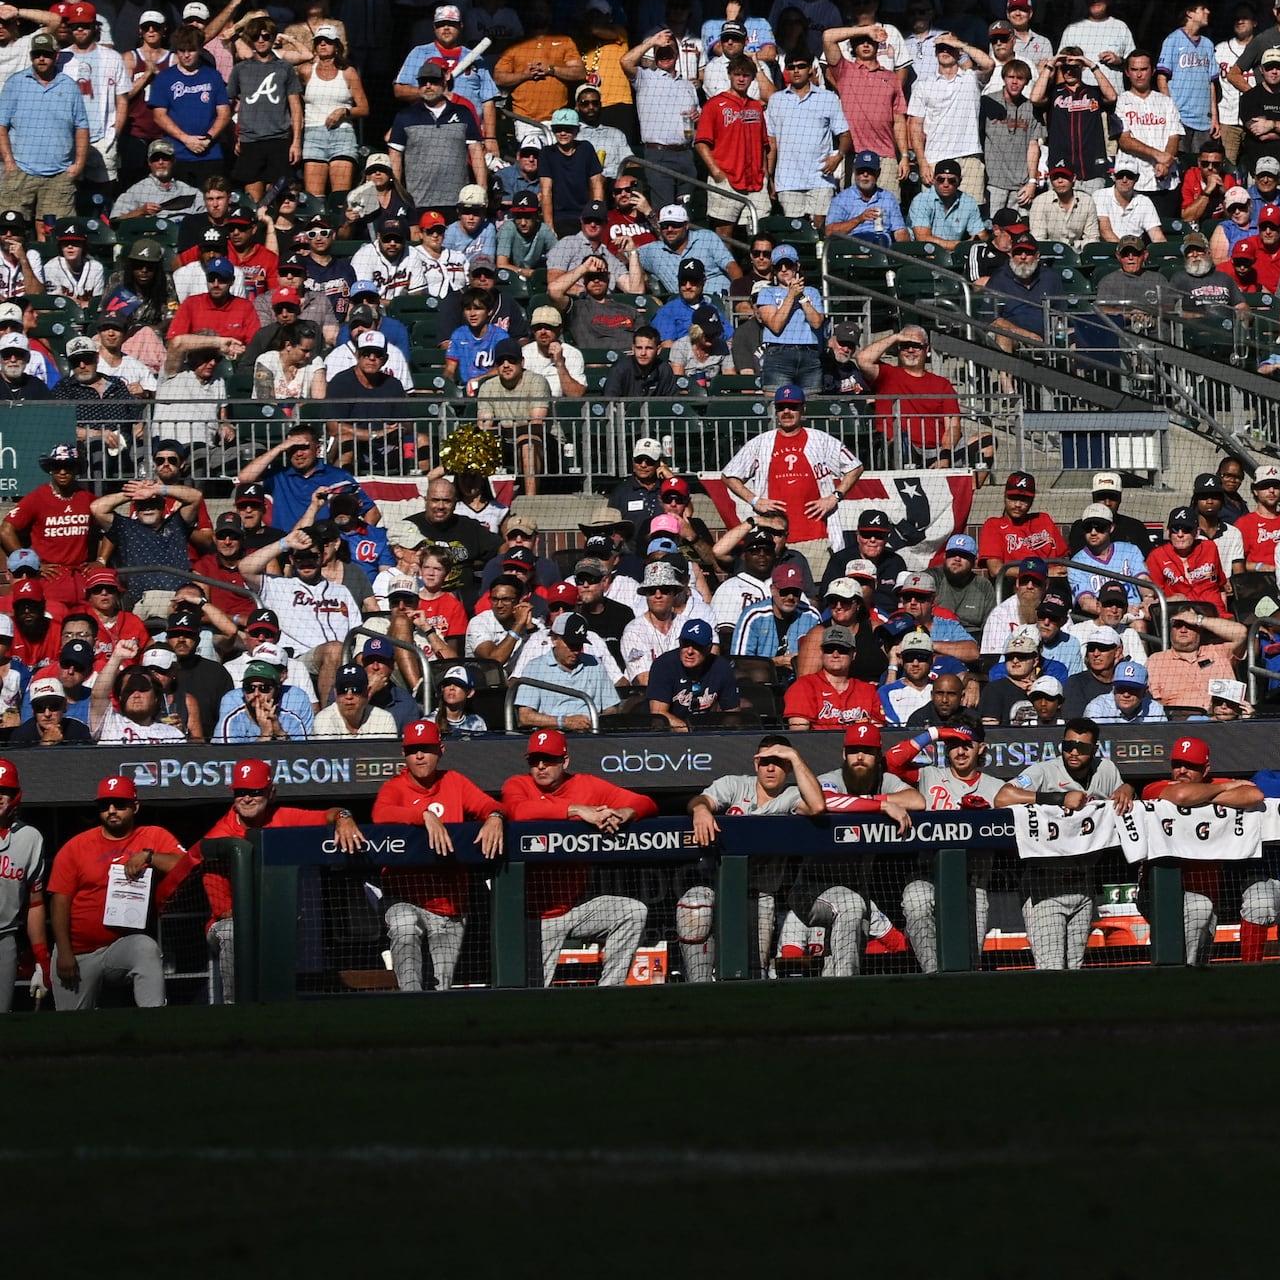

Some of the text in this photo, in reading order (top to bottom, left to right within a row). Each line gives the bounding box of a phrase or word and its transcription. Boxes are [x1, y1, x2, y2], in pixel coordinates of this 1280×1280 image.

[246, 72, 278, 104] A
[723, 108, 760, 126] Braves
[46, 514, 88, 527] MASCOT
[1005, 530, 1049, 552] Braves
[356, 540, 378, 561] a
[292, 592, 338, 610] Braves
[415, 724, 425, 736] P
[858, 726, 868, 737] P
[538, 733, 548, 746] P
[1116, 745, 1164, 756] 2026
[1182, 741, 1191, 752] P
[601, 749, 712, 772] abbvie
[241, 766, 251, 778] P
[108, 779, 118, 791] P
